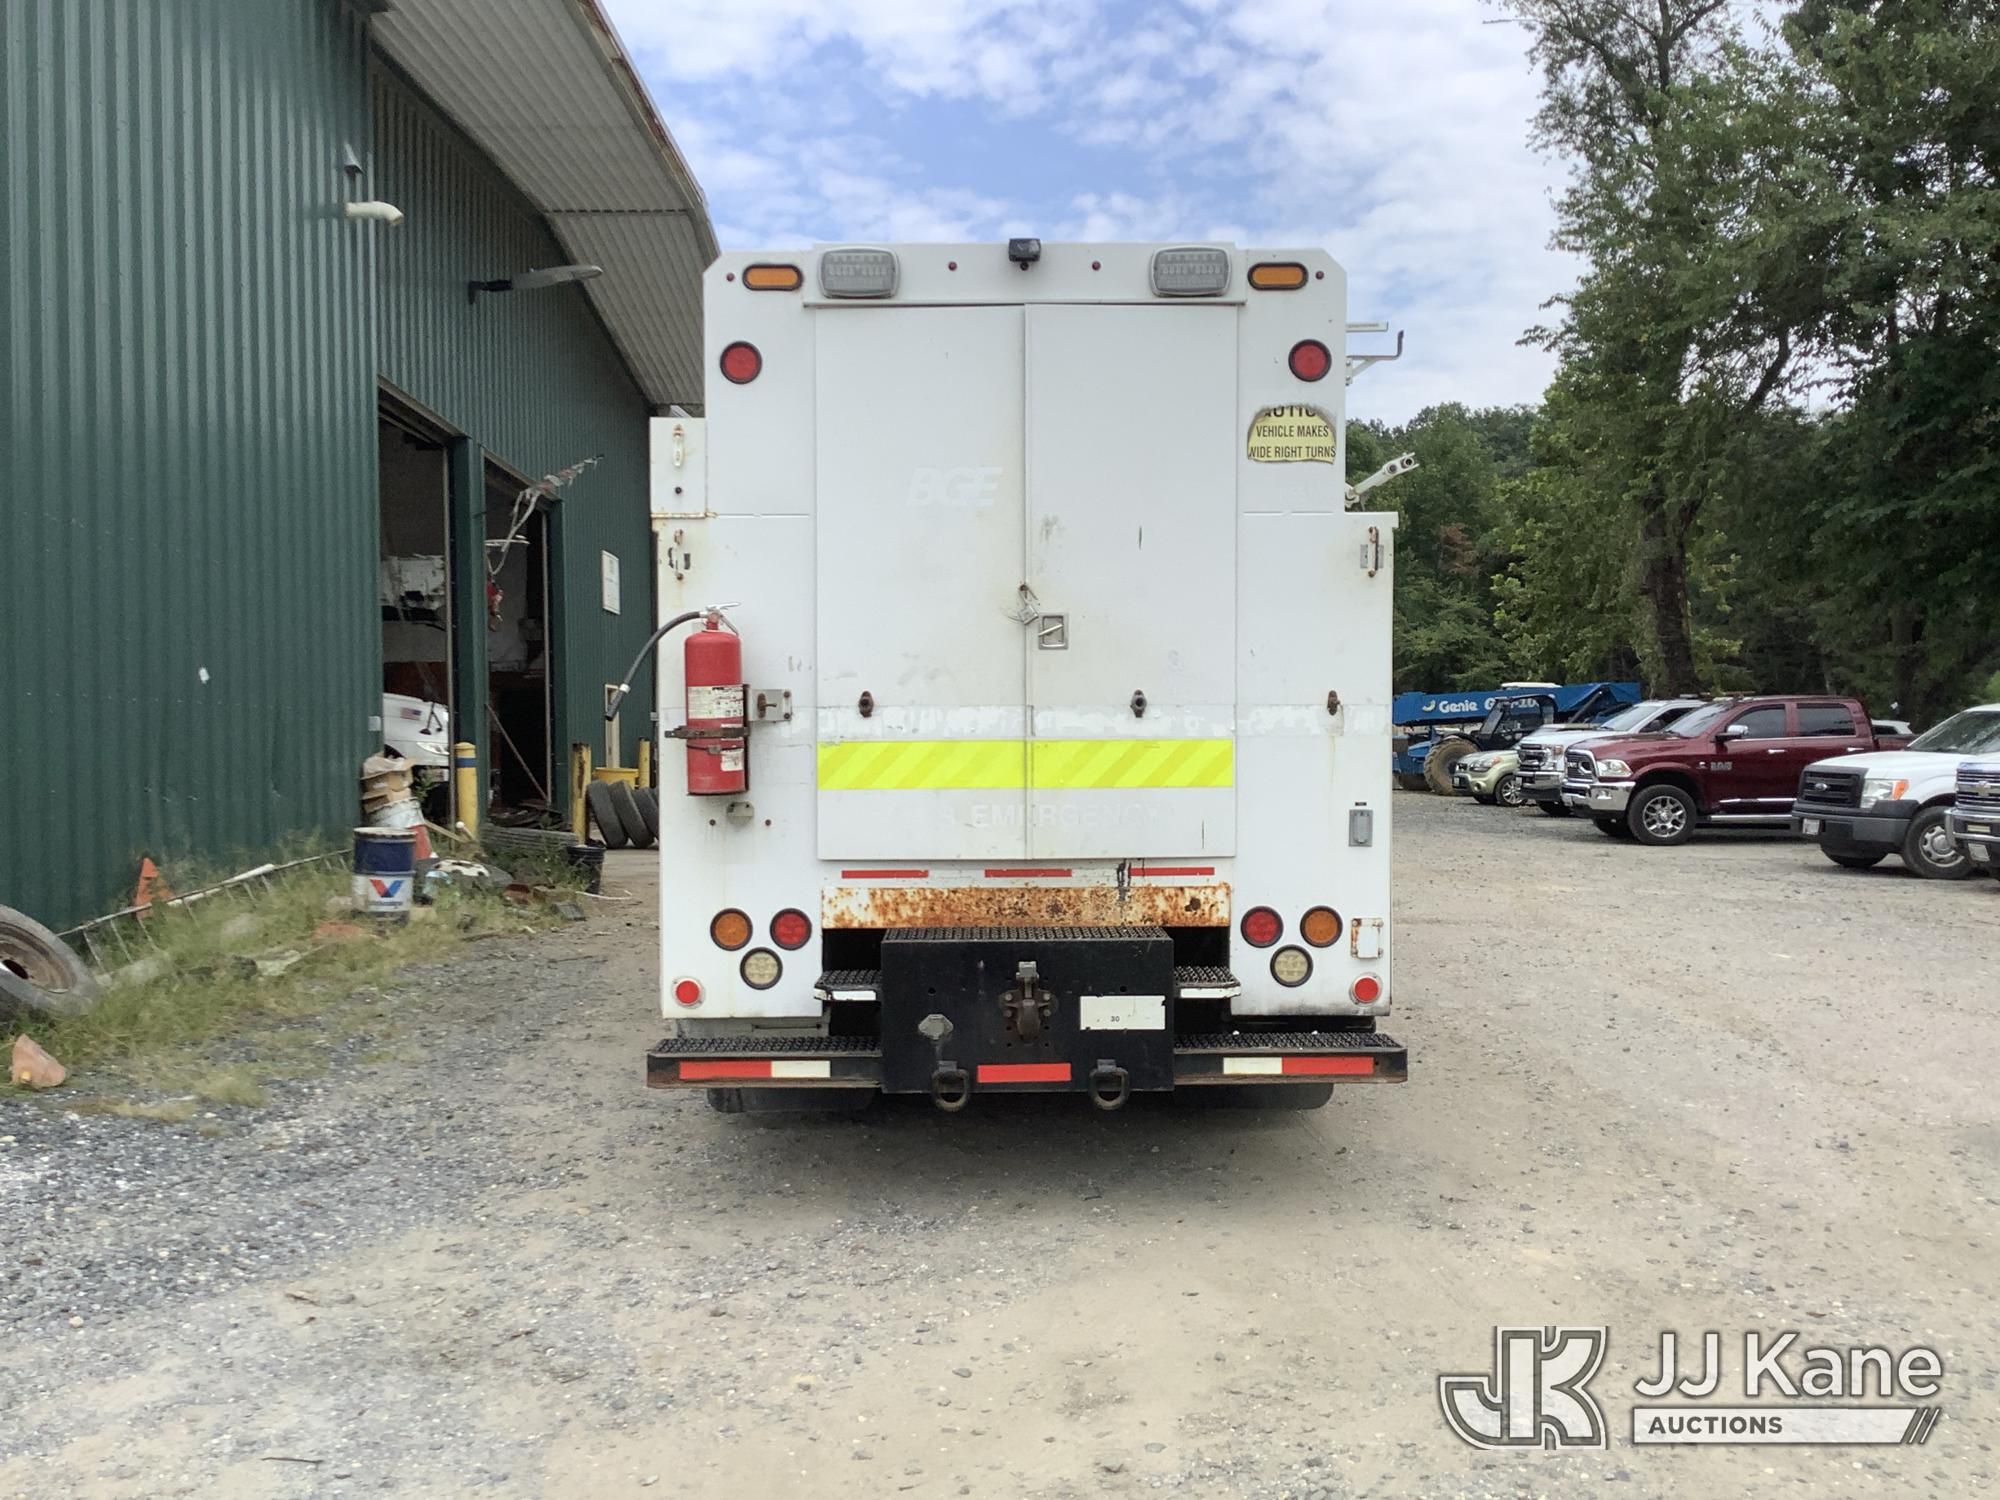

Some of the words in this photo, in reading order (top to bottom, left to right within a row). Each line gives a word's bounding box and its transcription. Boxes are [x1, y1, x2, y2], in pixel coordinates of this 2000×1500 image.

[1256, 425, 1295, 438] VEHICLE
[1297, 425, 1329, 438] MAKES
[1274, 446, 1303, 458] RIGHT
[1305, 446, 1337, 458] TURNS
[1438, 699, 1479, 713] Genie
